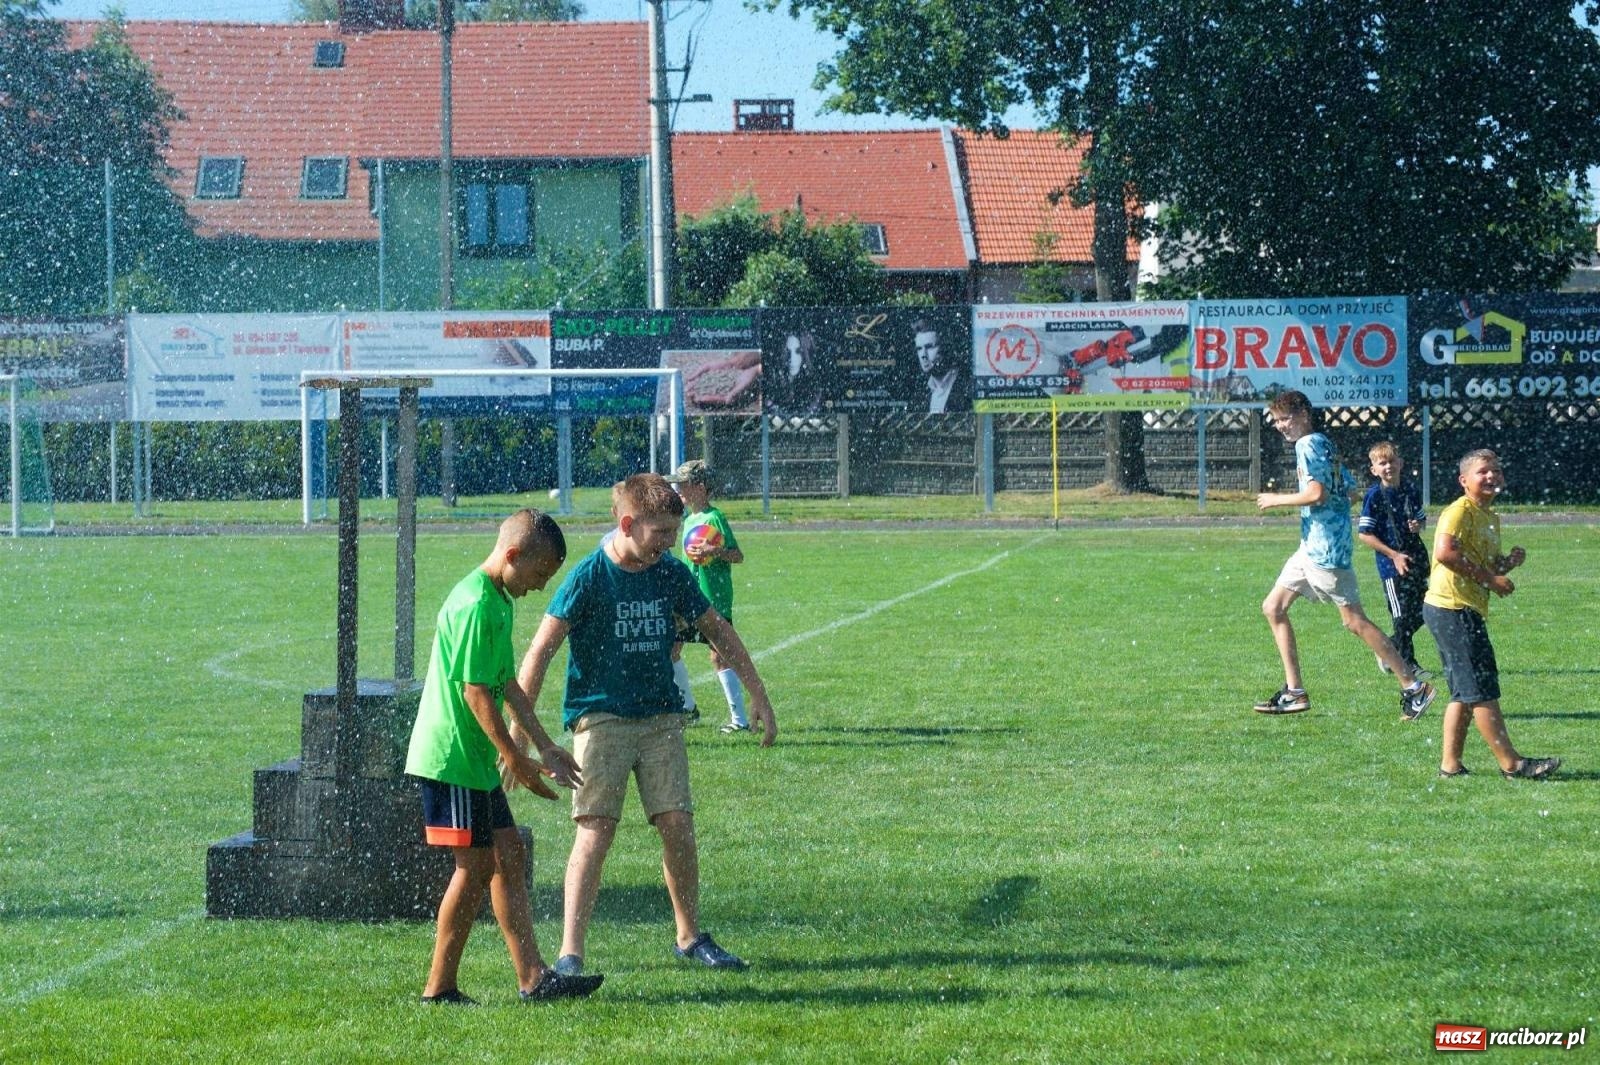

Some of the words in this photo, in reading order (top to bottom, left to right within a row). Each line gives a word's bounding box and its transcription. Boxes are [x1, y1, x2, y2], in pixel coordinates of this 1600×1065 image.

[1199, 304, 1293, 317] RESTAURACJA
[1299, 303, 1332, 315] DOM
[1337, 299, 1395, 314] PRZYJĘĆ
[977, 311, 1047, 319] PRZEWIERTY
[555, 339, 590, 351] BUBA
[1194, 323, 1398, 369] BRAVO
[1530, 350, 1556, 364] OD
[1561, 350, 1574, 364] A
[988, 378, 1014, 387] 608
[1018, 377, 1043, 386] 465
[1046, 377, 1070, 386] 635
[1302, 375, 1320, 386] tel.
[1325, 375, 1345, 386] 602
[1375, 374, 1395, 385] 173
[1420, 377, 1459, 399] tel.
[1465, 378, 1513, 398] 665
[1518, 376, 1568, 397] 092
[1324, 390, 1345, 401] 606
[1348, 389, 1370, 400] 270
[1373, 388, 1395, 399] 898
[616, 599, 664, 619] GAME
[614, 617, 667, 638] OVER
[622, 642, 637, 653] PLAY
[638, 641, 661, 652] REPEAT
